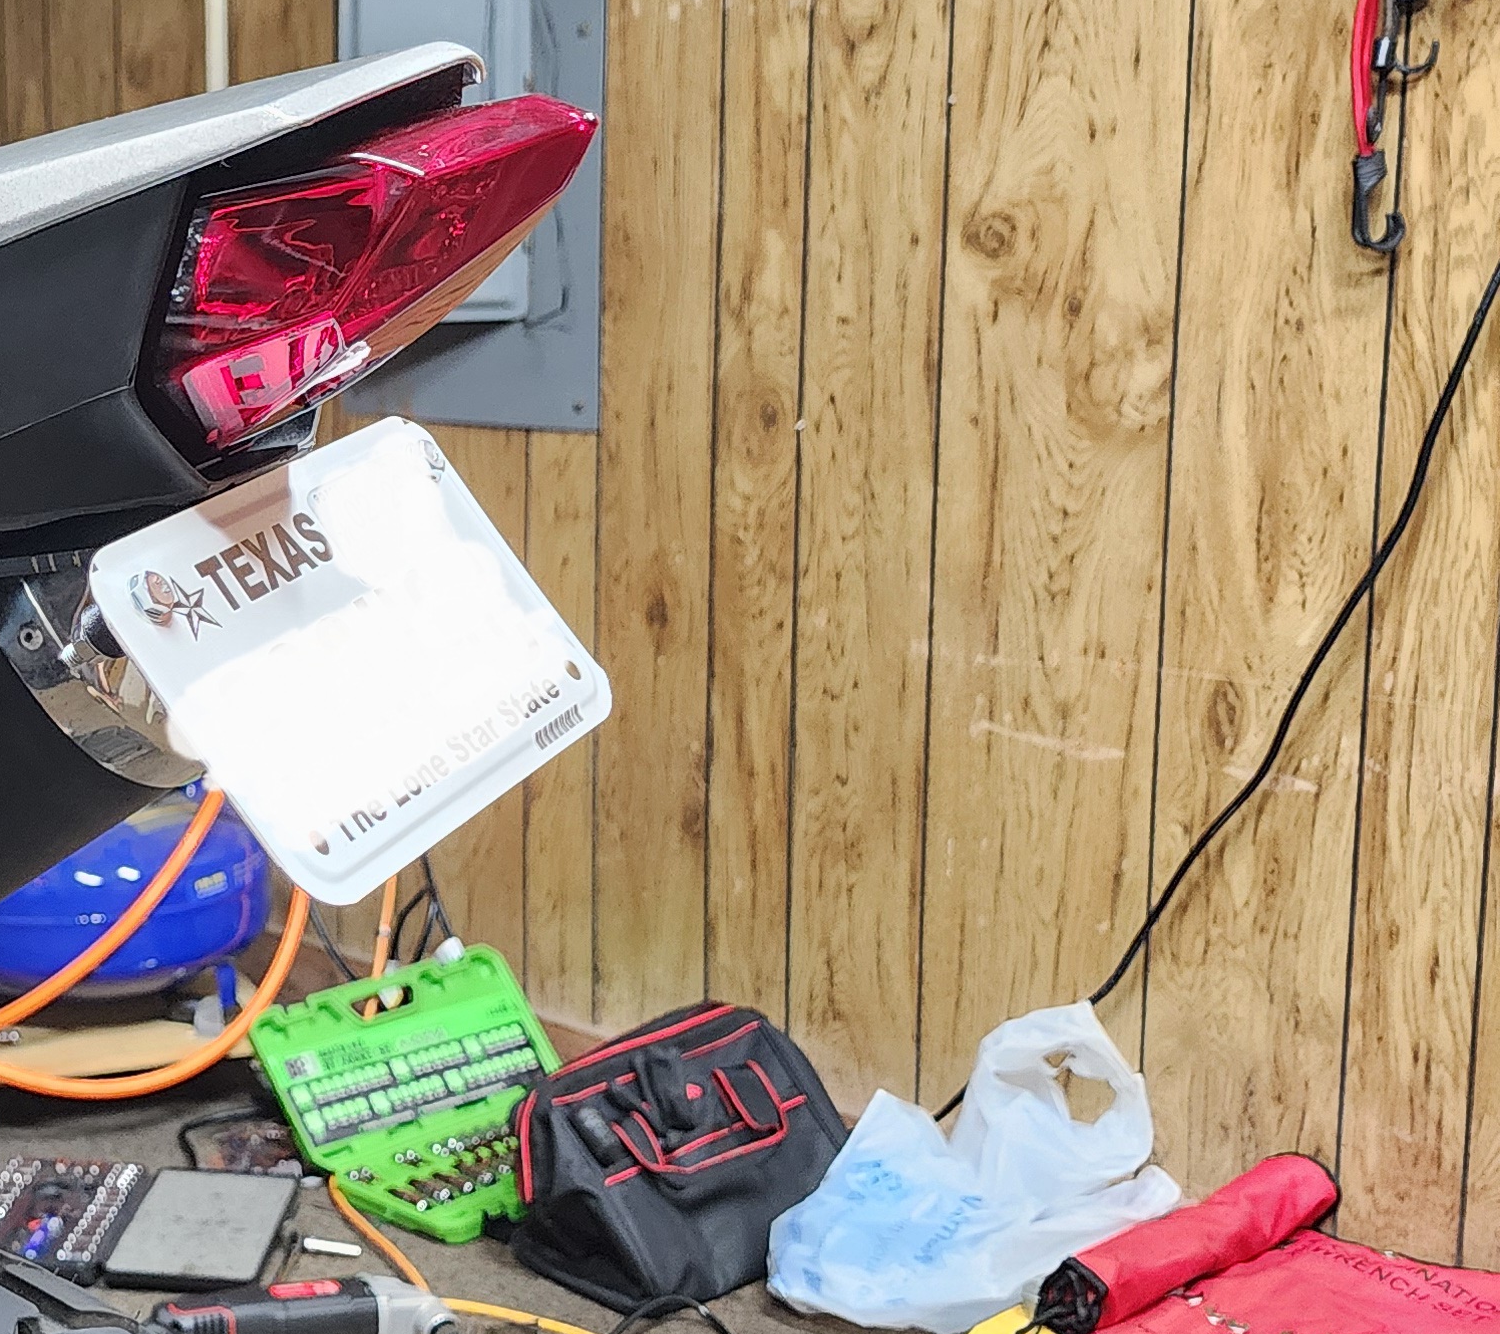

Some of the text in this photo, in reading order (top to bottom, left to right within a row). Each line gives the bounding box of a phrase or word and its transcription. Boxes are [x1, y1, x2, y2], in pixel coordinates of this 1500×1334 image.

[194, 512, 334, 611] TEXAS
[389, 753, 450, 808] Lone
[446, 716, 501, 763] Star
[496, 677, 561, 728] State
